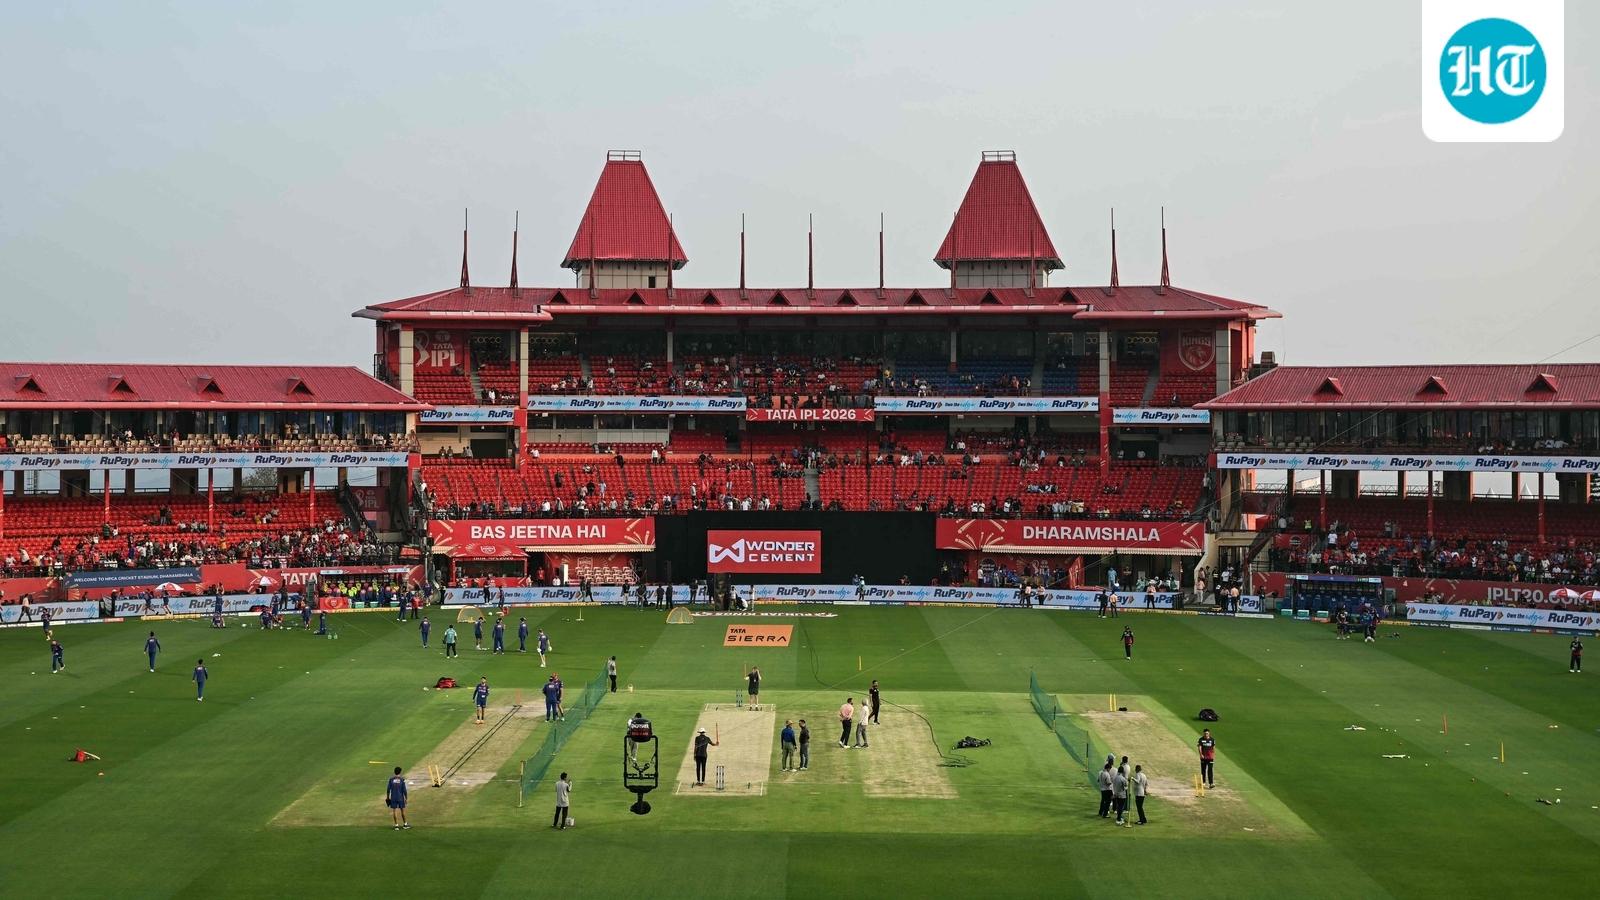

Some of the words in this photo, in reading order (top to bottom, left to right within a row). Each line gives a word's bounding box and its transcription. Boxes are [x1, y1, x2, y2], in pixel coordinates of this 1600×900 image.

[431, 350, 461, 367] IPL
[570, 399, 599, 409] RuPay
[639, 399, 668, 409] RuPay
[708, 400, 737, 410] RuPay
[906, 401, 937, 410] RuPay
[979, 401, 1010, 410] RuPay
[1052, 401, 1083, 410] RuPay
[488, 411, 513, 419] RuPa
[766, 409, 796, 420] TATA
[800, 409, 819, 420] IPL
[822, 409, 856, 420] 2026
[1141, 412, 1173, 421] RuPay
[20, 457, 54, 468] RuPay
[100, 456, 134, 467] RuPay
[178, 456, 211, 467] RuPay
[254, 455, 288, 466] RuPay
[330, 455, 363, 466] RuPay
[1225, 456, 1261, 467] RuPay
[1307, 457, 1343, 468] RuPay
[1390, 458, 1426, 469] RuPay
[1475, 459, 1512, 470] RuPay
[1562, 460, 1600, 471] RuPay
[471, 525, 505, 539] BAS
[509, 525, 573, 539] JEETNA
[577, 525, 606, 538] HAI
[1023, 525, 1160, 542] DHARAMSHALA
[746, 541, 815, 551] WONDER
[749, 553, 815, 562] CEMENT
[281, 572, 318, 585] TATA
[541, 589, 577, 602] RuPay
[777, 587, 810, 599] RuPay
[934, 589, 969, 600] RuPay
[113, 603, 142, 614] uPay
[1240, 598, 1260, 611] Pay
[30, 605, 59, 619] uPay
[1459, 608, 1497, 621] RuPay
[1548, 612, 1587, 626] RuPay
